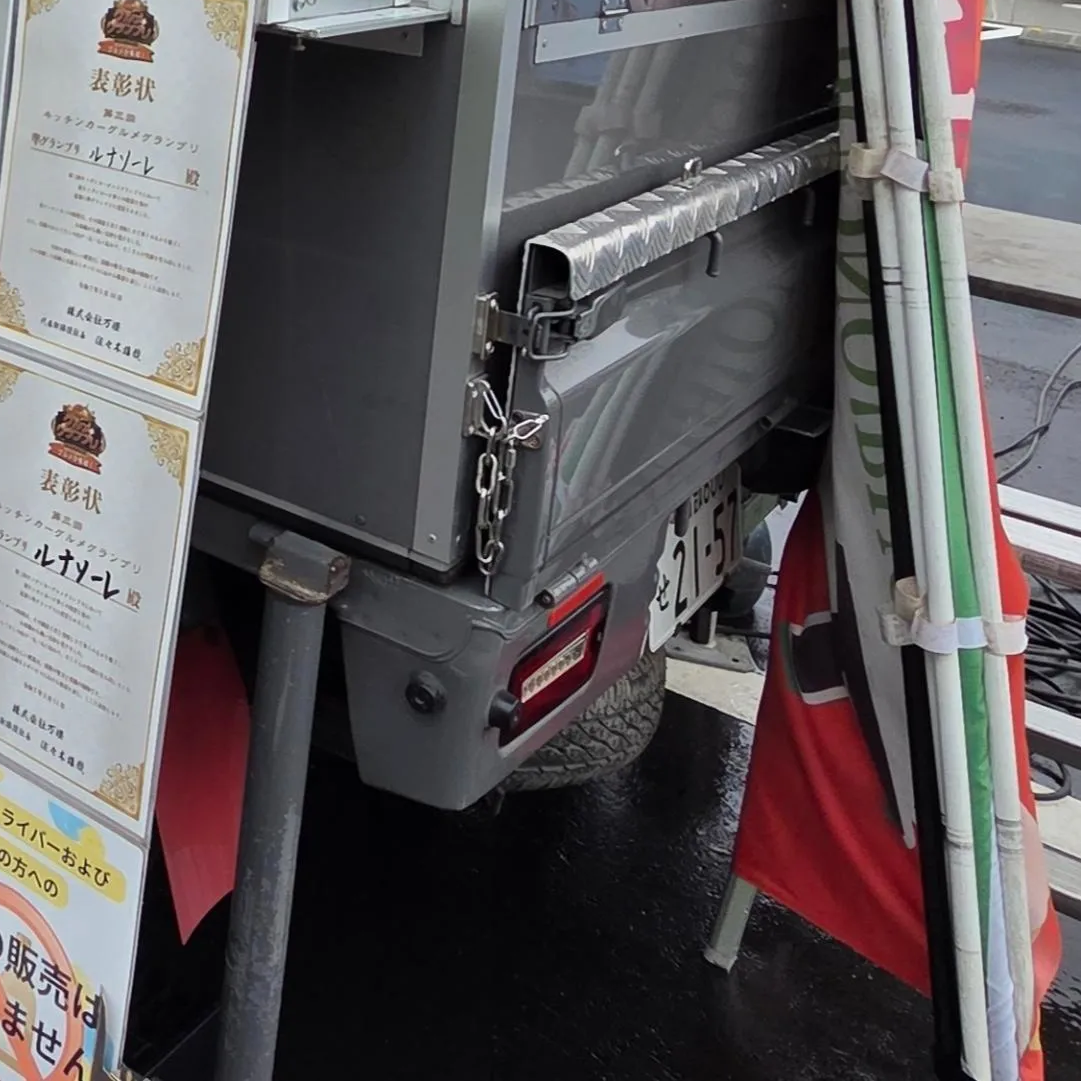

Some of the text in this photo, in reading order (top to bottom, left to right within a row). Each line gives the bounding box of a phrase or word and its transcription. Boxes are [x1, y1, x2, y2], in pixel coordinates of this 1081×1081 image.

[89, 67, 156, 103] 表彰状
[88, 146, 155, 176] ルナソーレ
[39, 468, 103, 515] 表彰状
[33, 543, 120, 600] ルナソーレ
[672, 487, 739, 619] 21-57
